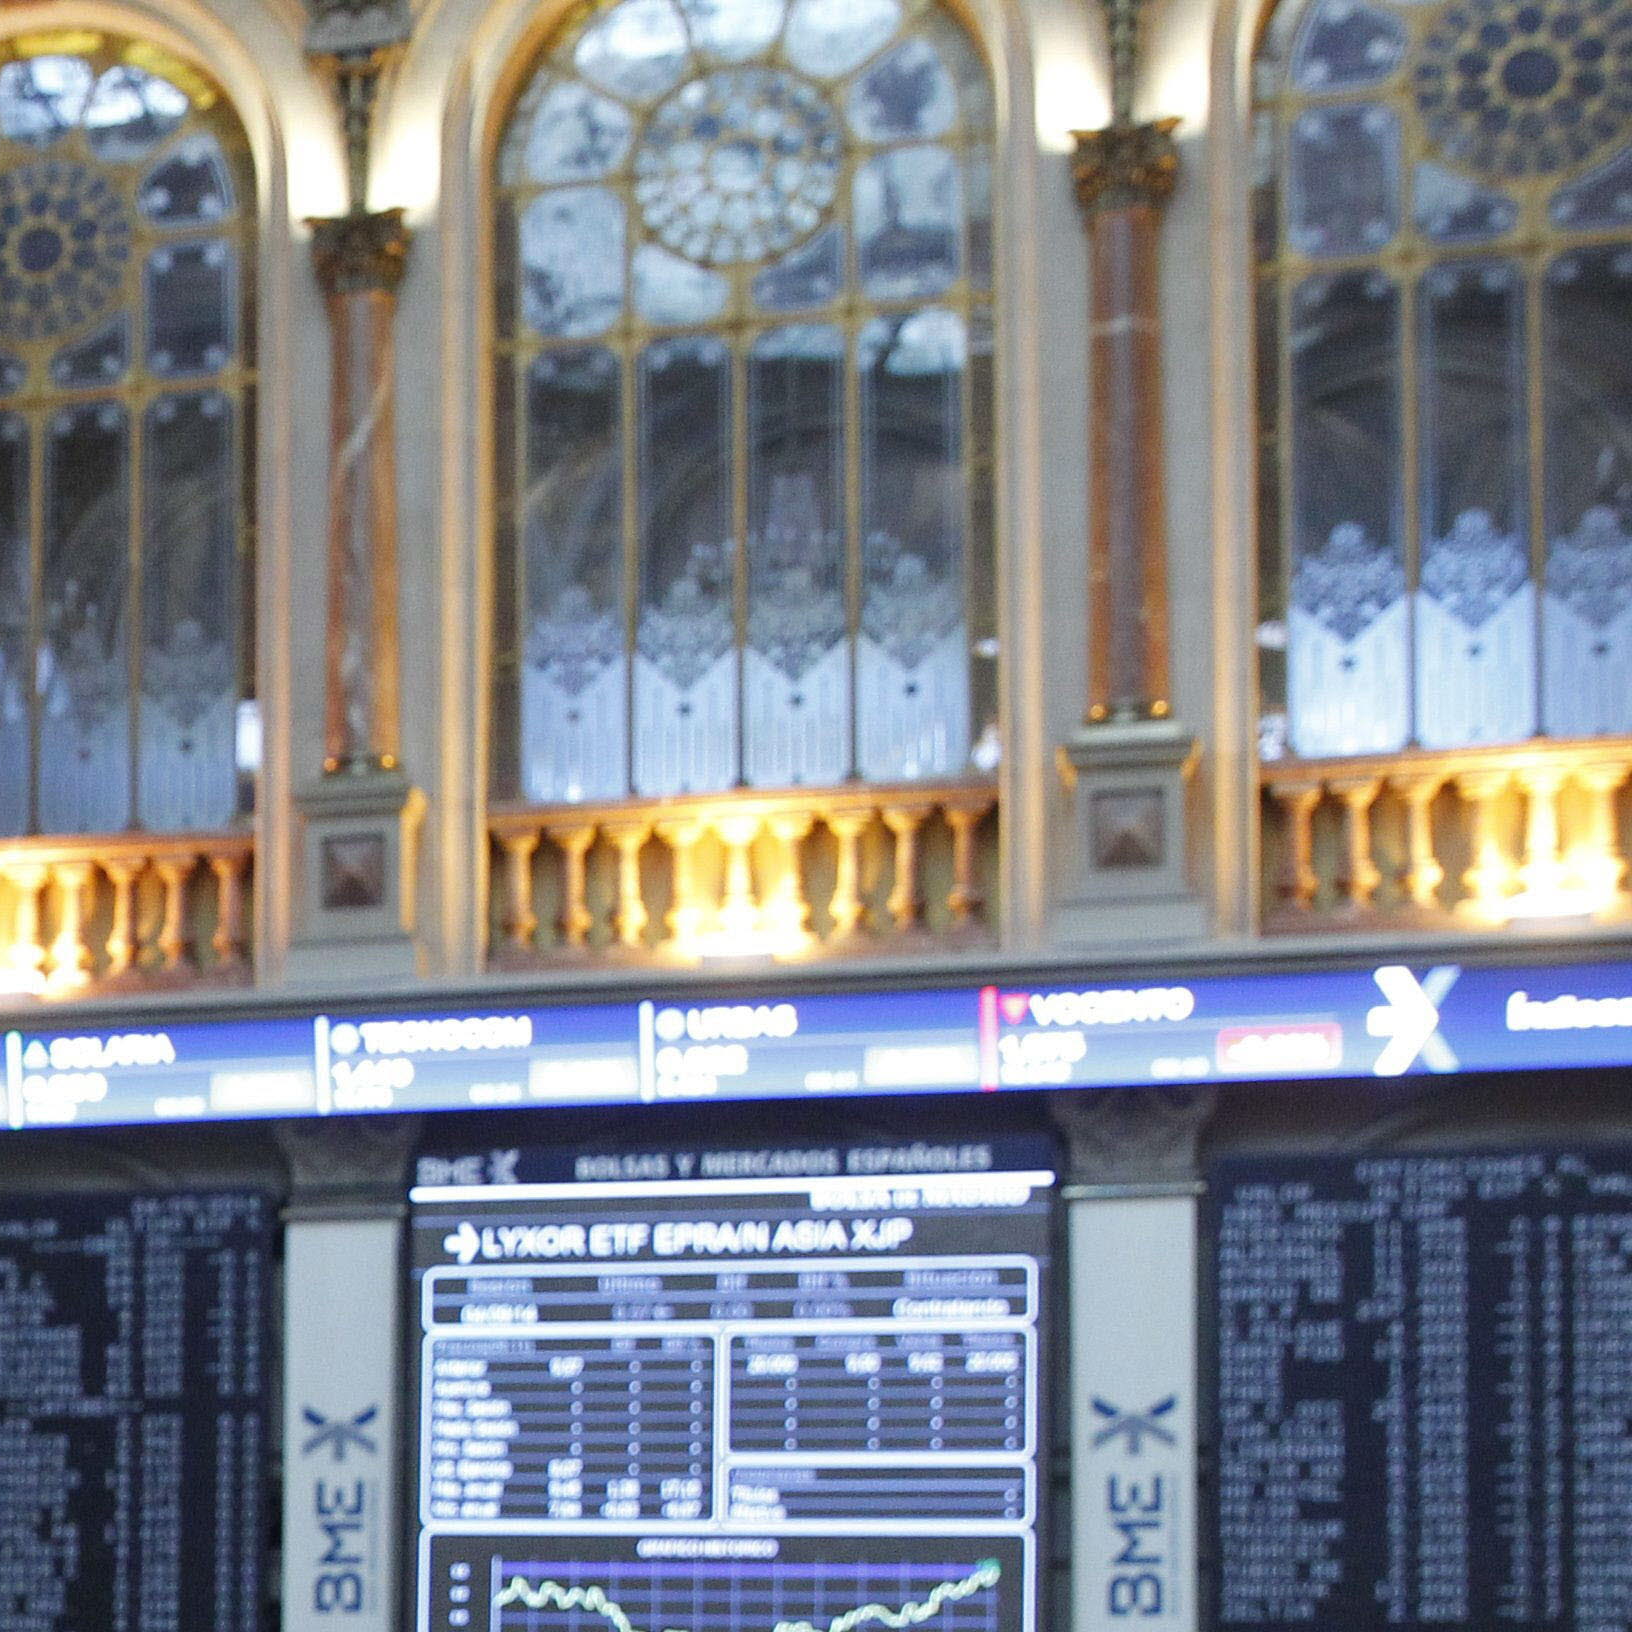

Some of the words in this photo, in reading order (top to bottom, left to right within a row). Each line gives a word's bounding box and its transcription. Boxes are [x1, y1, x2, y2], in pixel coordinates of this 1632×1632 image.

[675, 1155, 694, 1178] Y
[700, 1151, 839, 1177] MERCADOS
[483, 1223, 586, 1258] LYXOR
[588, 1221, 649, 1256] ETF
[772, 1219, 848, 1255] ASIA
